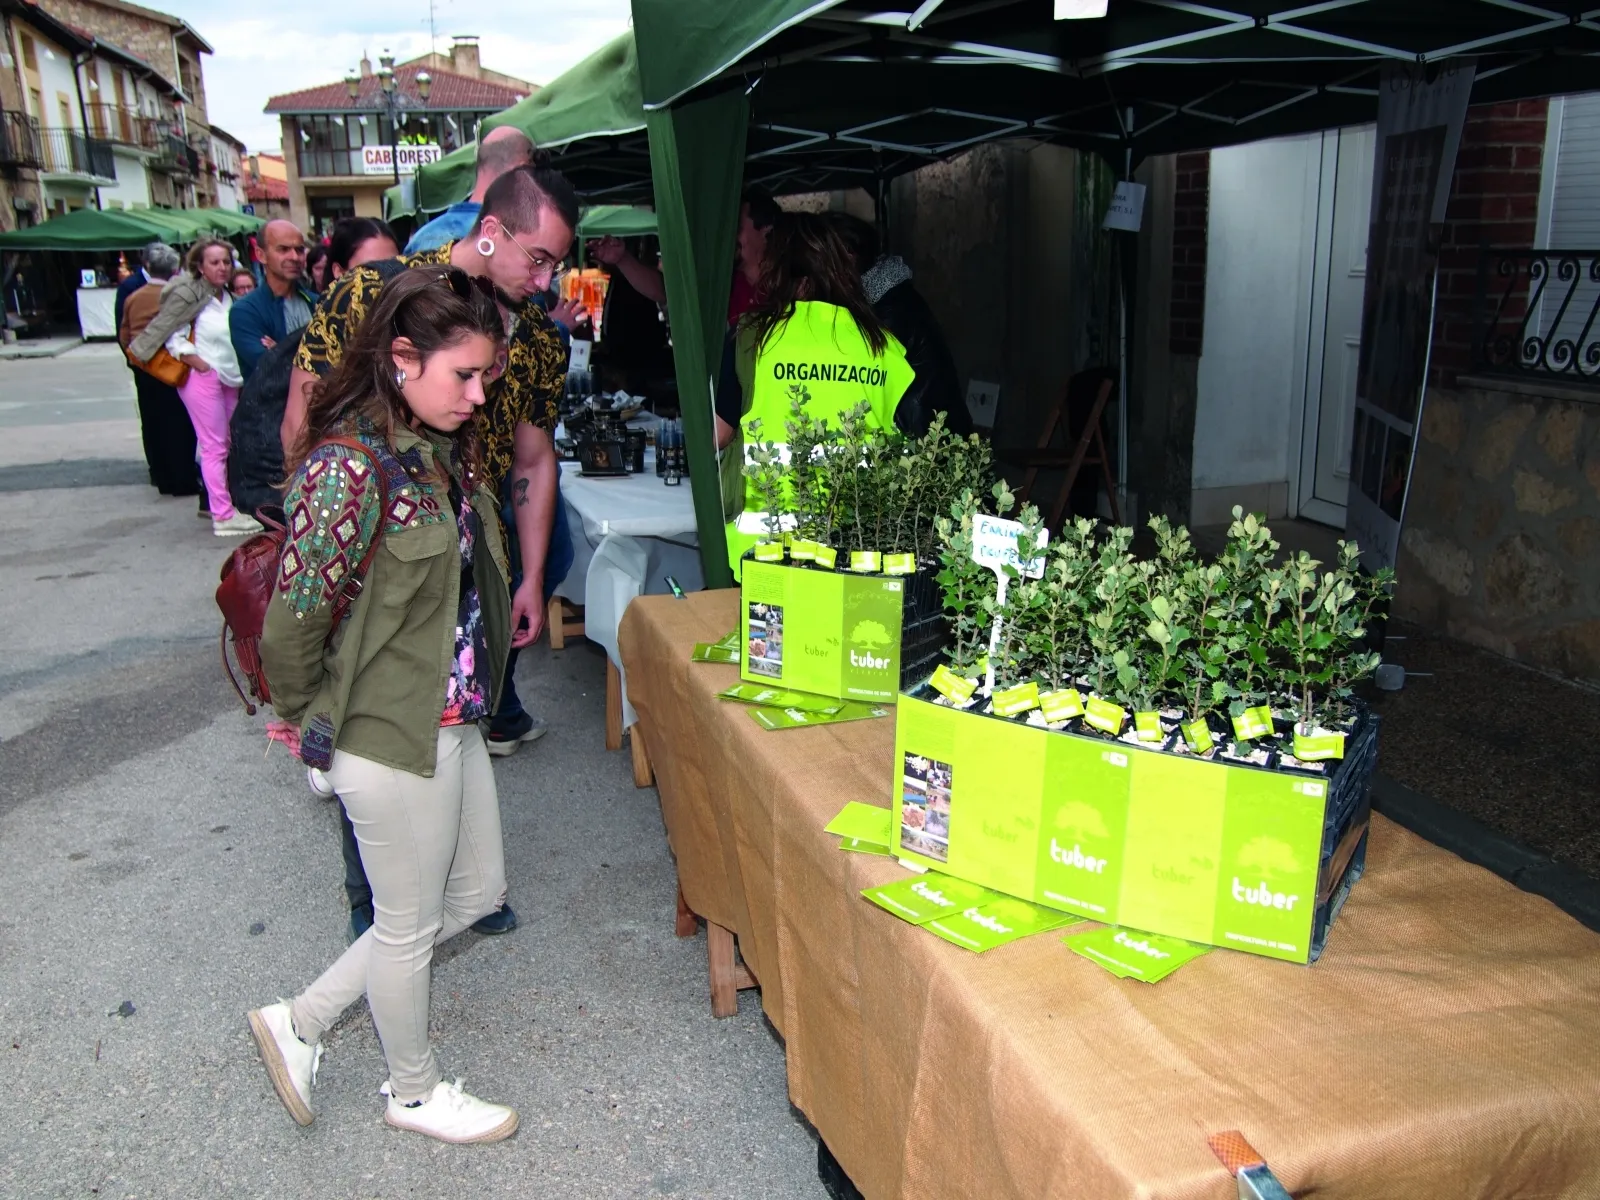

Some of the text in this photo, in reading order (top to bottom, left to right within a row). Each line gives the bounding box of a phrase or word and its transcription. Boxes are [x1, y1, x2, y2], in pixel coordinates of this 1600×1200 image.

[365, 149, 439, 165] CABOREST
[773, 362, 888, 387] ORGANIZACIÓN
[804, 643, 829, 657] tuber
[850, 649, 891, 669] tuber
[982, 819, 1019, 843] tuber
[1049, 837, 1108, 875] tuber
[1151, 862, 1196, 886] tuber
[1231, 876, 1300, 911] tuber
